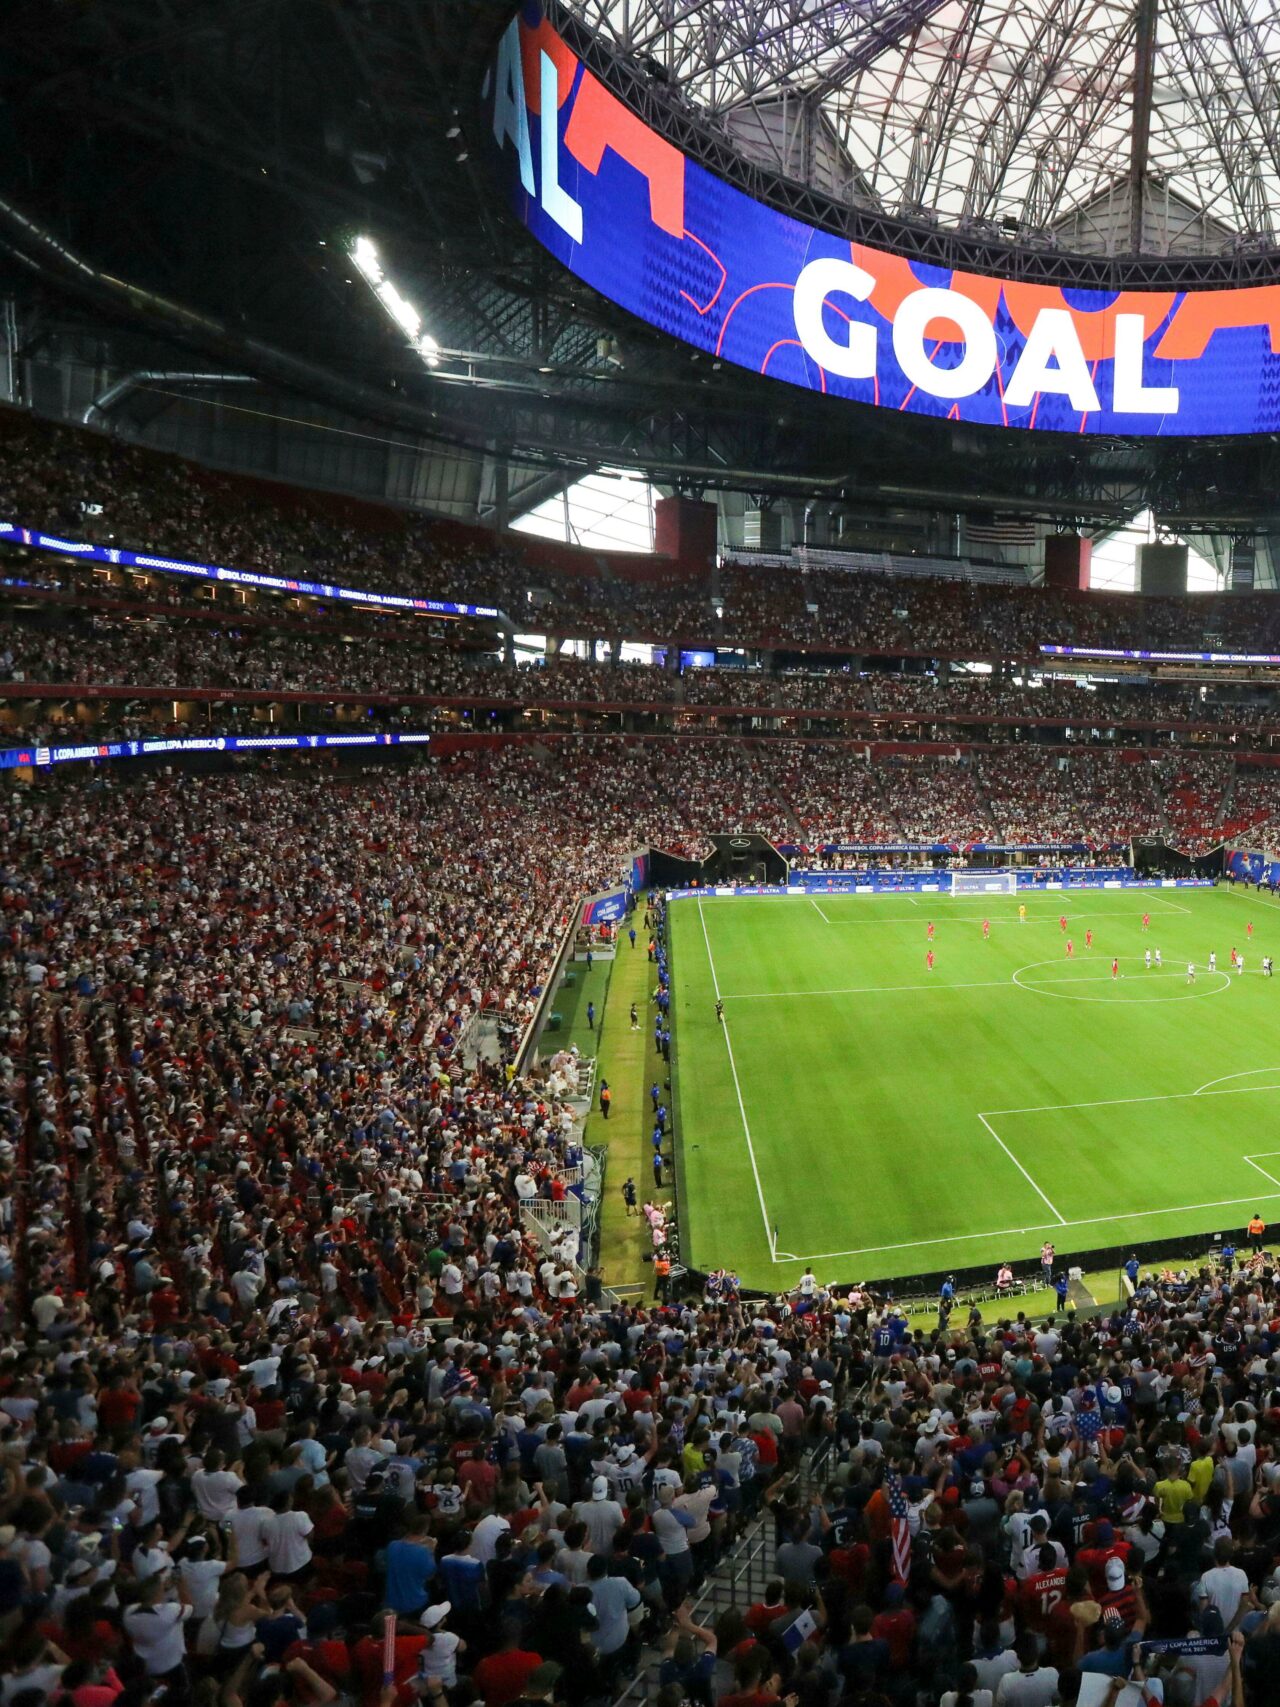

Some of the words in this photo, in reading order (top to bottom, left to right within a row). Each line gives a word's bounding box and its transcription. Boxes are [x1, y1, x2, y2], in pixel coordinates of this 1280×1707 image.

[483, 16, 583, 245] AL
[793, 257, 1179, 414] GOAL
[880, 1334, 891, 1346] 10
[1224, 1345, 1237, 1353] USA
[981, 1366, 997, 1374] USA
[1123, 1387, 1132, 1397] 10
[1003, 1445, 1014, 1461] 9
[1041, 1590, 1062, 1615] 12
[1169, 1640, 1188, 1649] COPA
[1189, 1638, 1220, 1648] AMERICA
